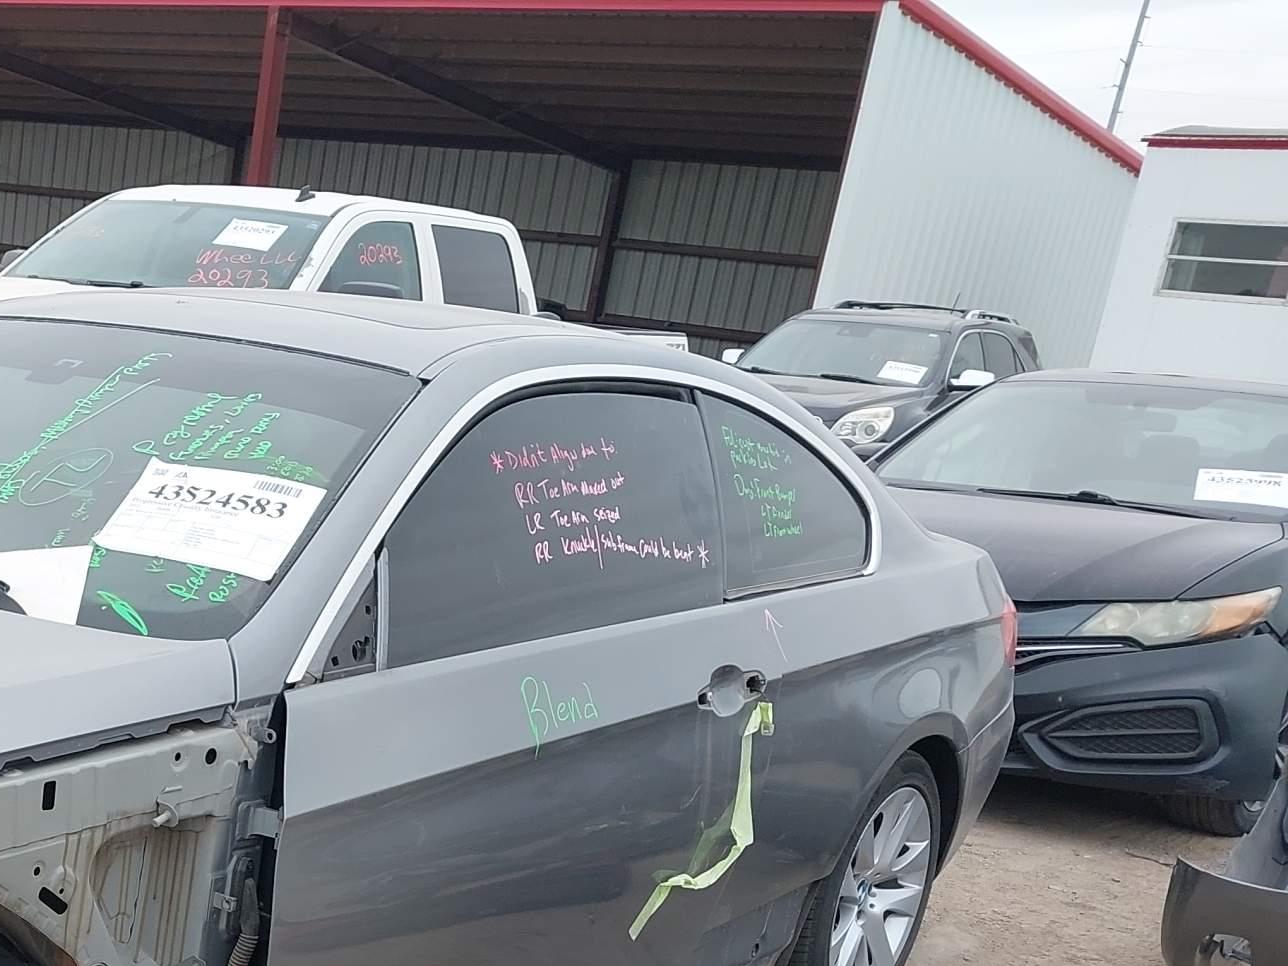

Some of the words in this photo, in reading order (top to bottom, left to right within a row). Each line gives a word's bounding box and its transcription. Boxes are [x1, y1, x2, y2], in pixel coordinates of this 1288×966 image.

[360, 242, 402, 265] 20293
[188, 267, 269, 288] 20293
[149, 484, 288, 519] 43524583
[514, 481, 540, 509] RR
[526, 513, 545, 534] LR
[535, 541, 553, 564] RR
[520, 676, 599, 756] Blend
